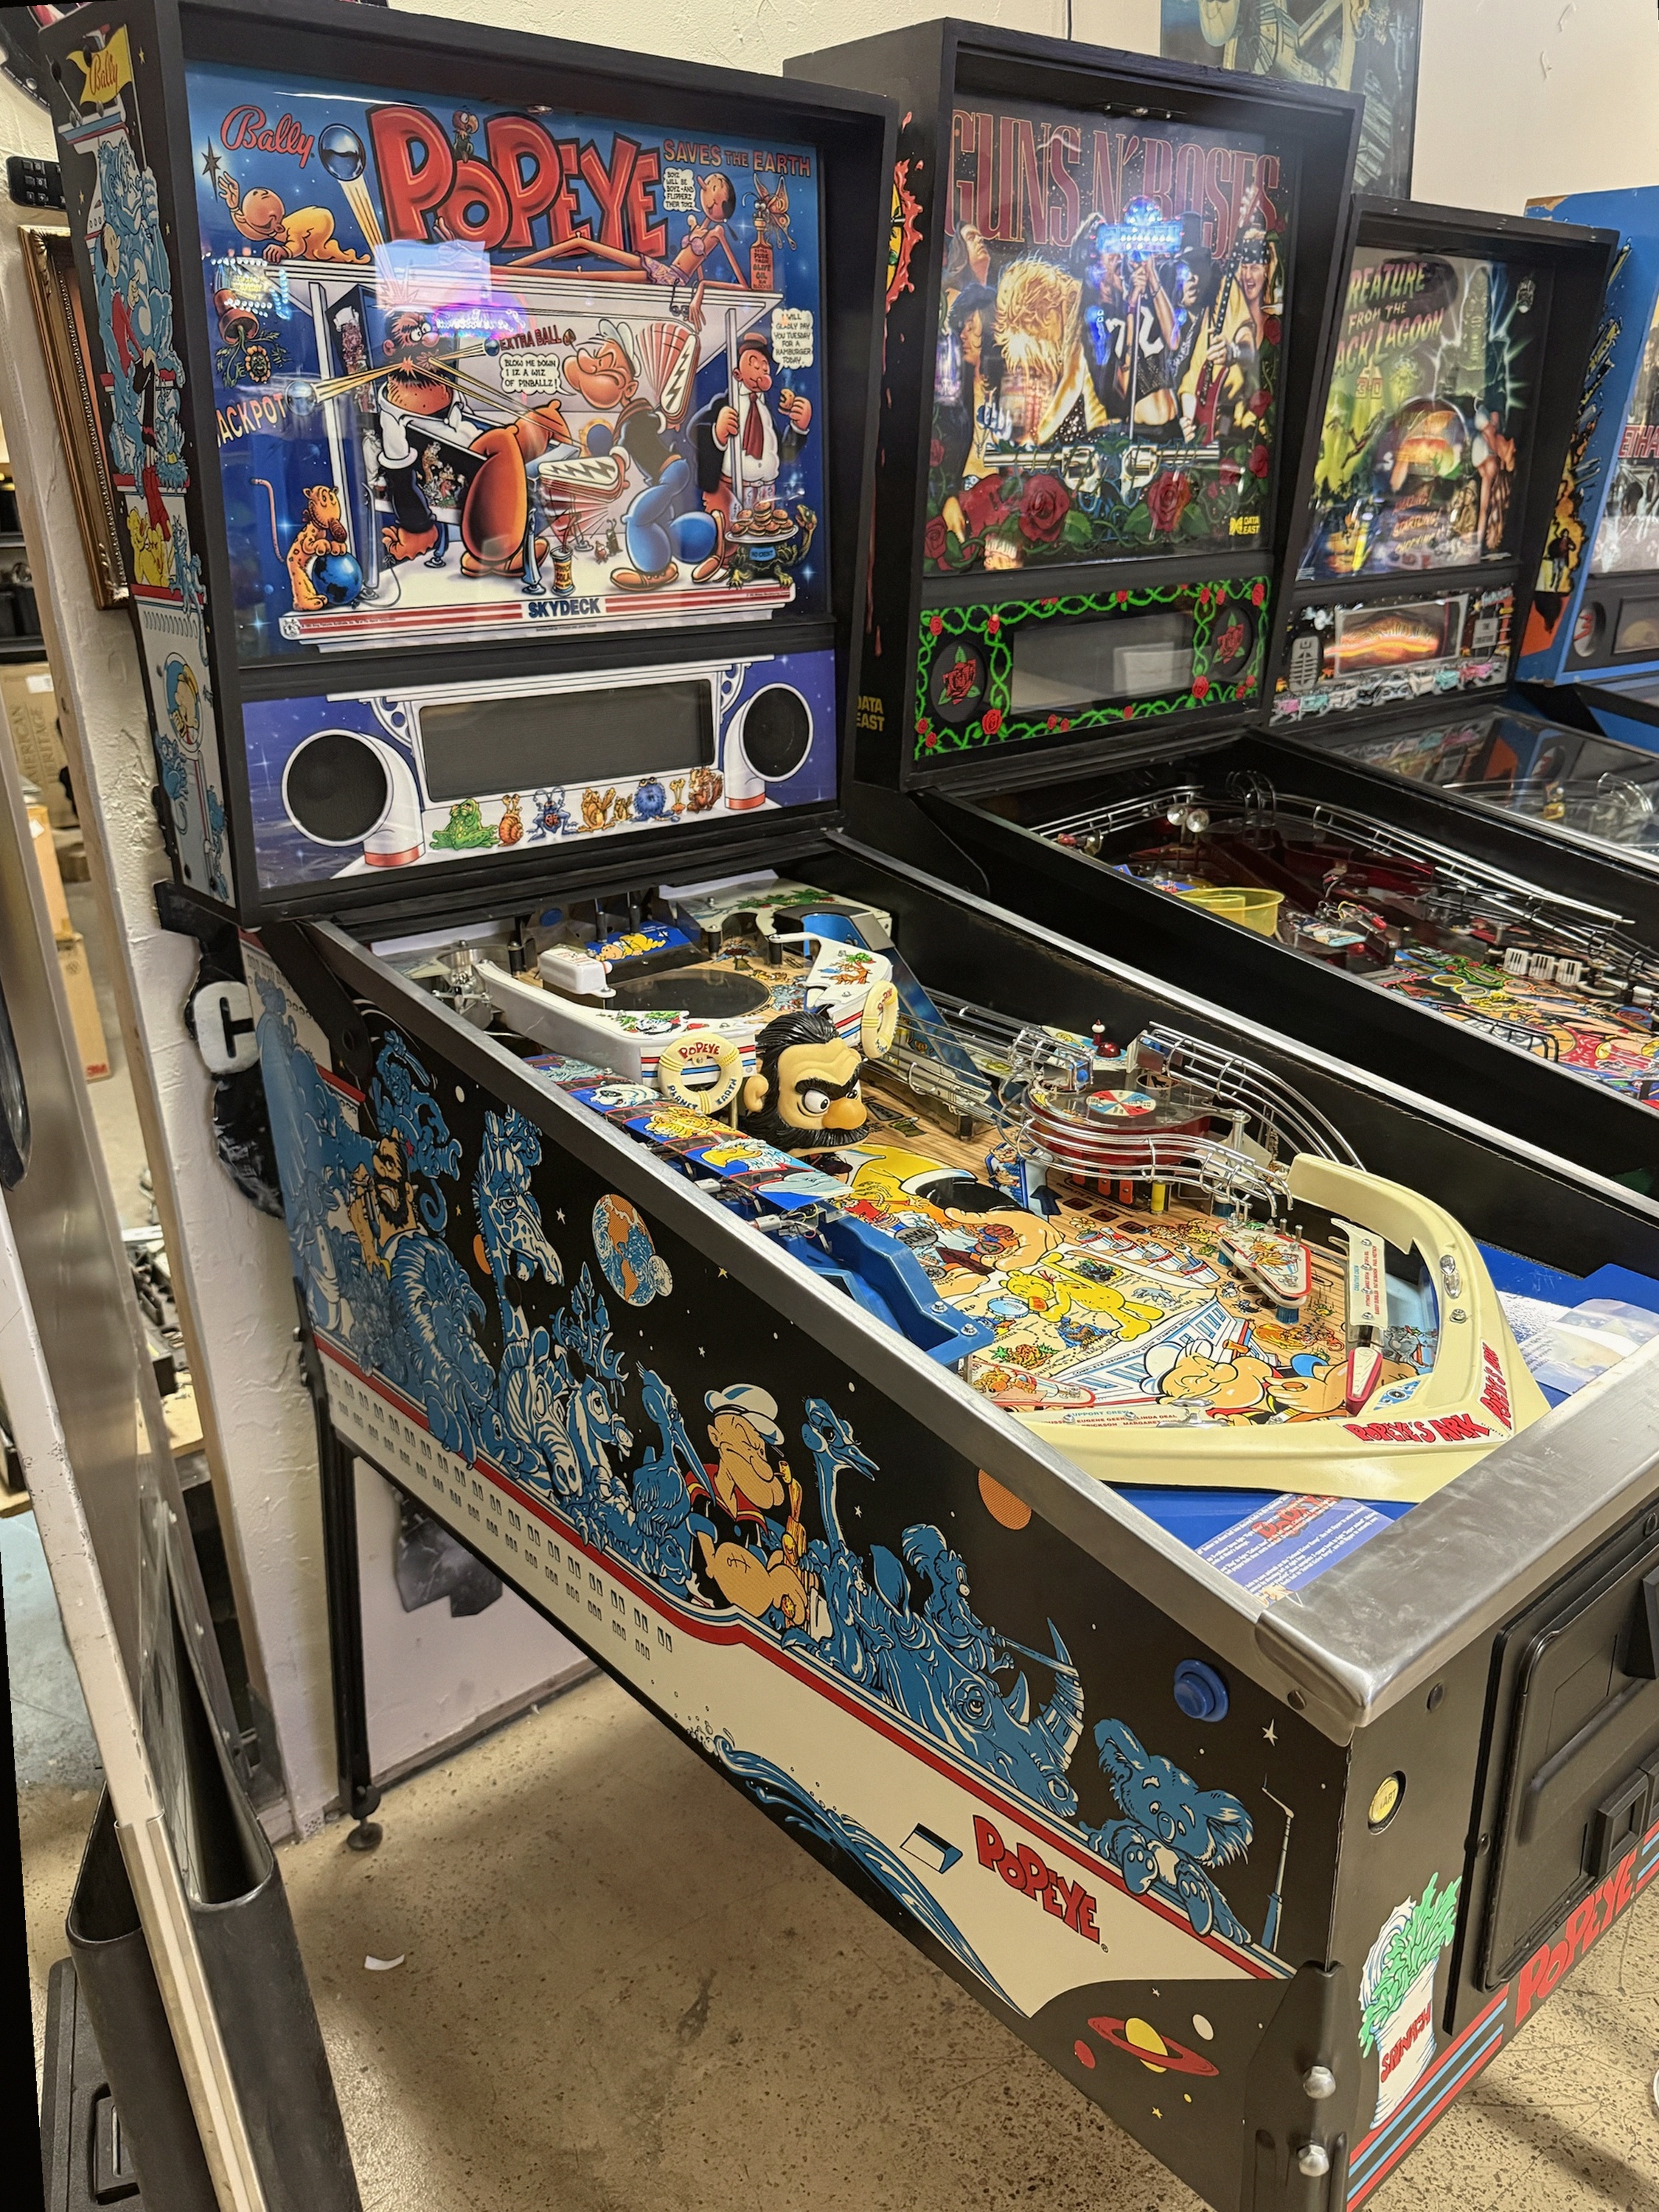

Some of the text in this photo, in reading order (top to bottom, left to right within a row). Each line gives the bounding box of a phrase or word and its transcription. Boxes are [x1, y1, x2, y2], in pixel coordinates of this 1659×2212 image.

[88, 50, 119, 95] Bally
[221, 105, 315, 169] Bally
[664, 138, 811, 178] SAVES THE EARTH
[365, 102, 667, 260] POPEYE
[945, 109, 1081, 247] GUNS
[1143, 137, 1281, 260] ROSES
[1348, 301, 1408, 335] FROM THE
[499, 330, 536, 351] EXTRA
[535, 324, 563, 347] BALL
[773, 332, 811, 340] YOU TUESDAY
[1373, 307, 1444, 364] LAGOON
[504, 359, 524, 367] BLOW
[537, 359, 556, 367] DOWN
[506, 369, 509, 377] I
[523, 369, 529, 377] A
[531, 369, 546, 377] WIZ
[518, 379, 558, 389] PINBALLZ!
[1243, 525, 1260, 535] EAST
[528, 598, 601, 619] SKYDECK
[678, 1041, 720, 1060] POPEYE
[667, 1079, 737, 1110] PLANET EARTH
[897, 1228, 926, 1240] SAVE
[904, 1231, 933, 1245] OLIVE
[1072, 1363, 1105, 1376] COMPLETE
[1106, 1353, 1130, 1364] GEOMAP
[1141, 1340, 1156, 1352] BEGIN
[1157, 1325, 1179, 1341] STAMPEDE
[1180, 1317, 1191, 1326] MODE
[1482, 1341, 1503, 1377] ARK
[1342, 1421, 1436, 1443] POPEYE'S
[1428, 1413, 1490, 1442] ARK
[973, 1815, 1100, 1945] POPEYE
[1515, 1848, 1638, 2028] POPEYE
[1380, 2003, 1431, 2084] SPINACH
